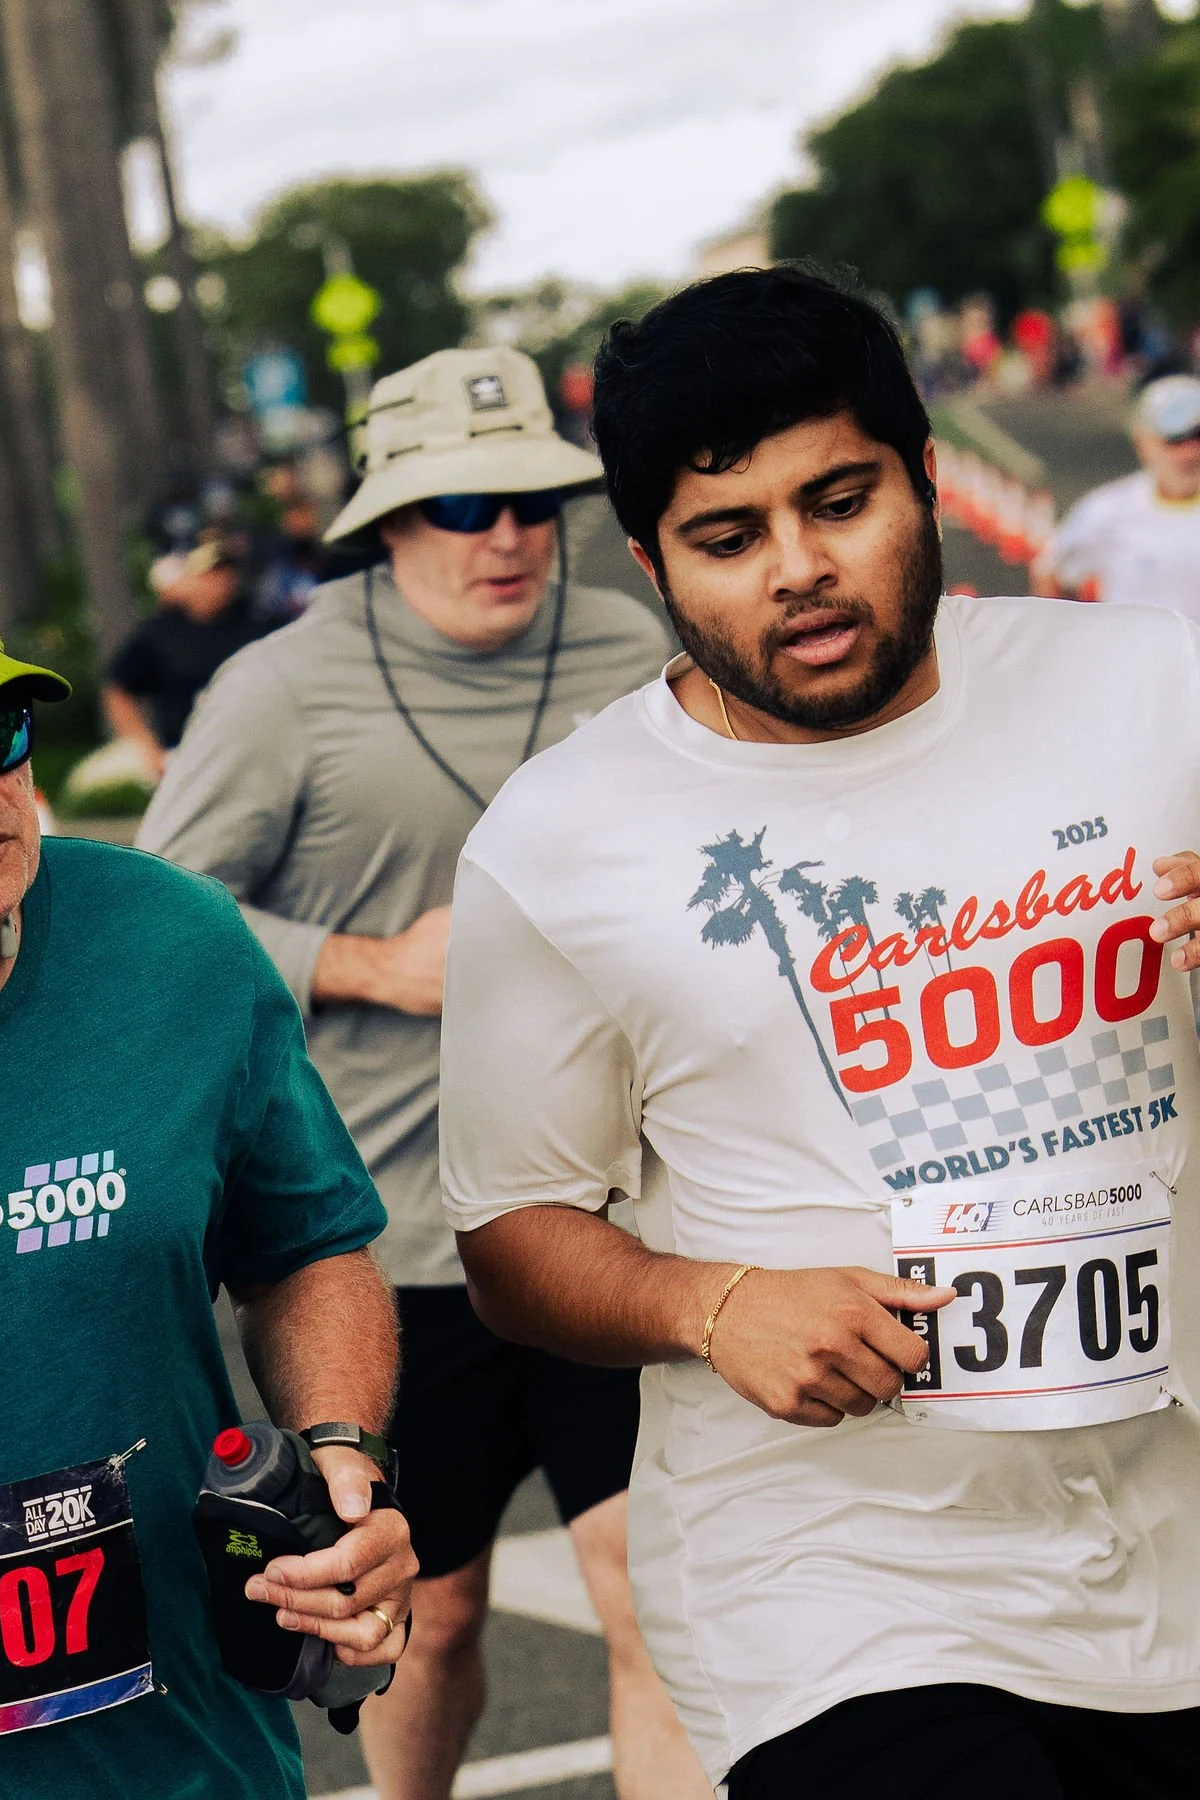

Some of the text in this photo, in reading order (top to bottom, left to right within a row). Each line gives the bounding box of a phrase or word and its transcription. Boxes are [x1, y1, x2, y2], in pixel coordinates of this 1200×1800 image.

[1050, 815, 1108, 851] 2025
[808, 846, 1143, 994] Carlsbad
[828, 915, 1165, 1093] 5000
[882, 1093, 1179, 1191] WORLD'S FASTEST 5K
[1012, 1183, 1143, 1217] CARLSBAD5000
[1041, 1205, 1126, 1226] 40 YEARS OF FAST
[950, 1248, 1160, 1373] 3705
[25, 1504, 46, 1522] ALL
[25, 1518, 46, 1536] DAY
[45, 1491, 96, 1531] 20K
[225, 1544, 263, 1559] amphipod
